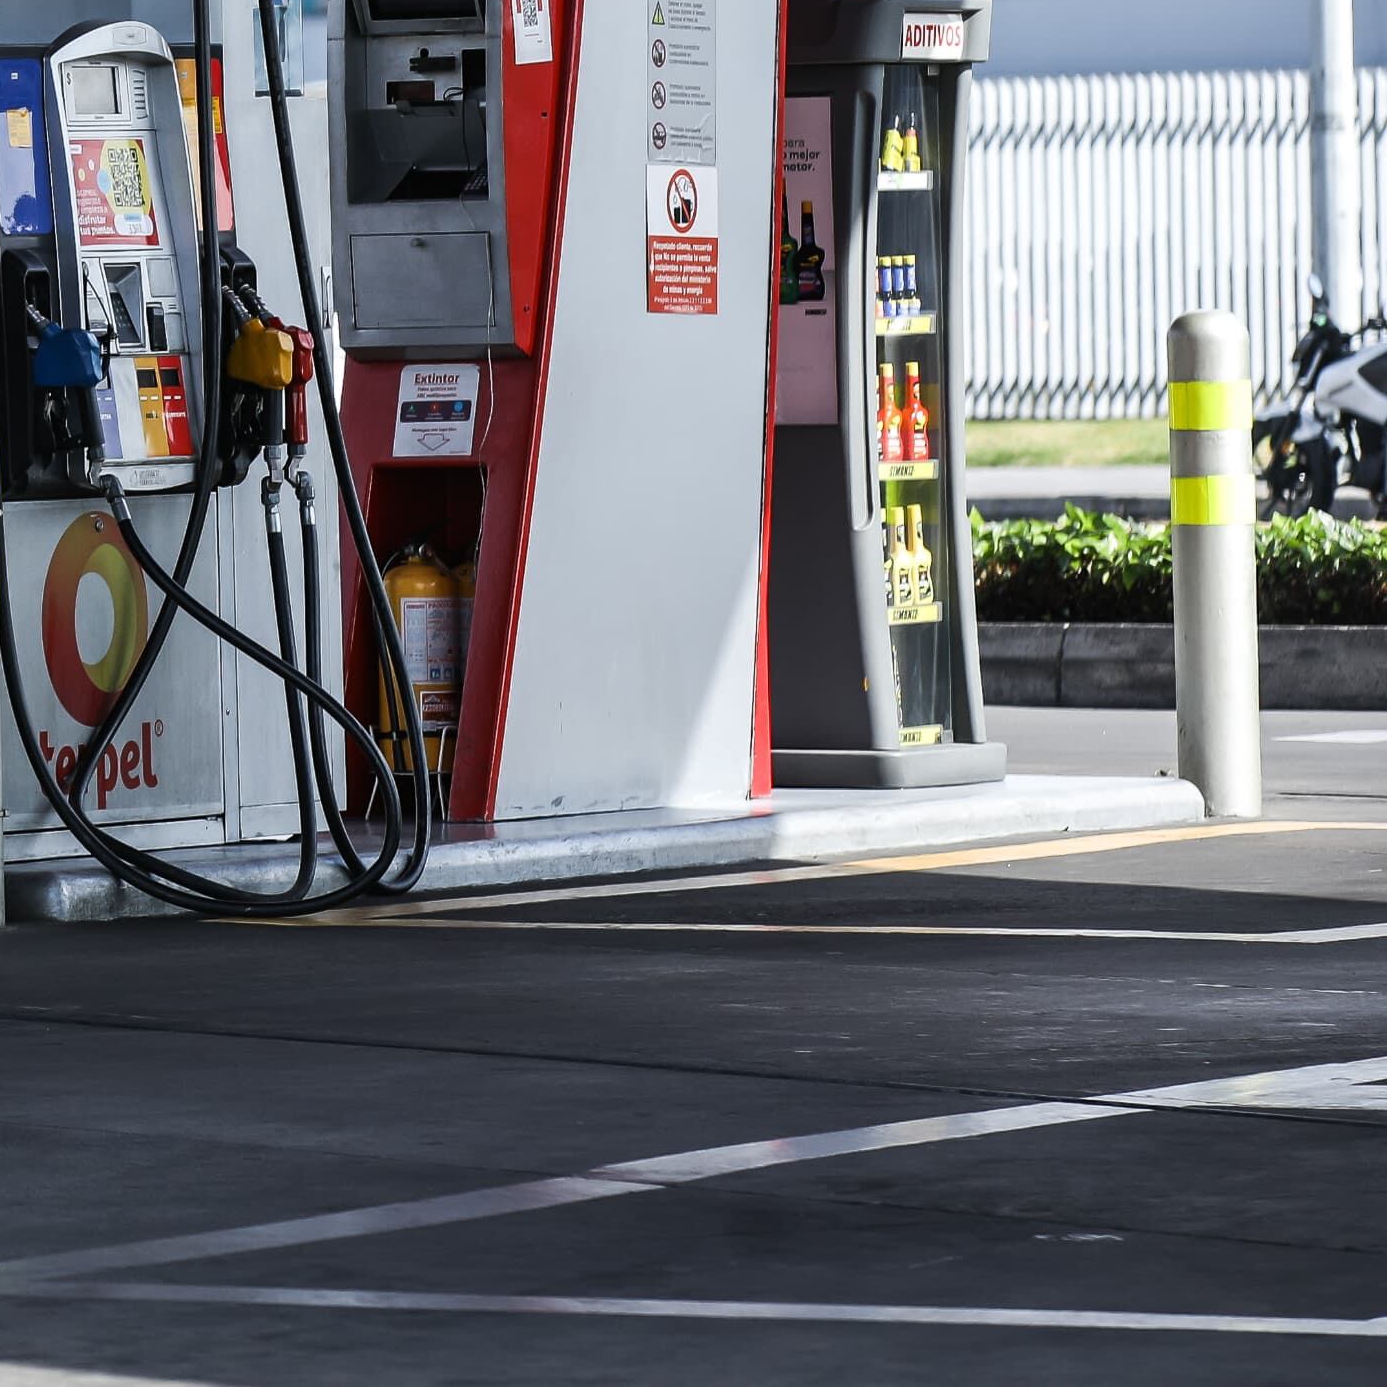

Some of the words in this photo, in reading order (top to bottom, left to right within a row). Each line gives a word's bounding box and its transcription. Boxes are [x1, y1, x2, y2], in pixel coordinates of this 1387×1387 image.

[905, 25, 960, 46] ADITIVOS
[790, 148, 820, 162] mejor
[415, 372, 459, 384] Extintor
